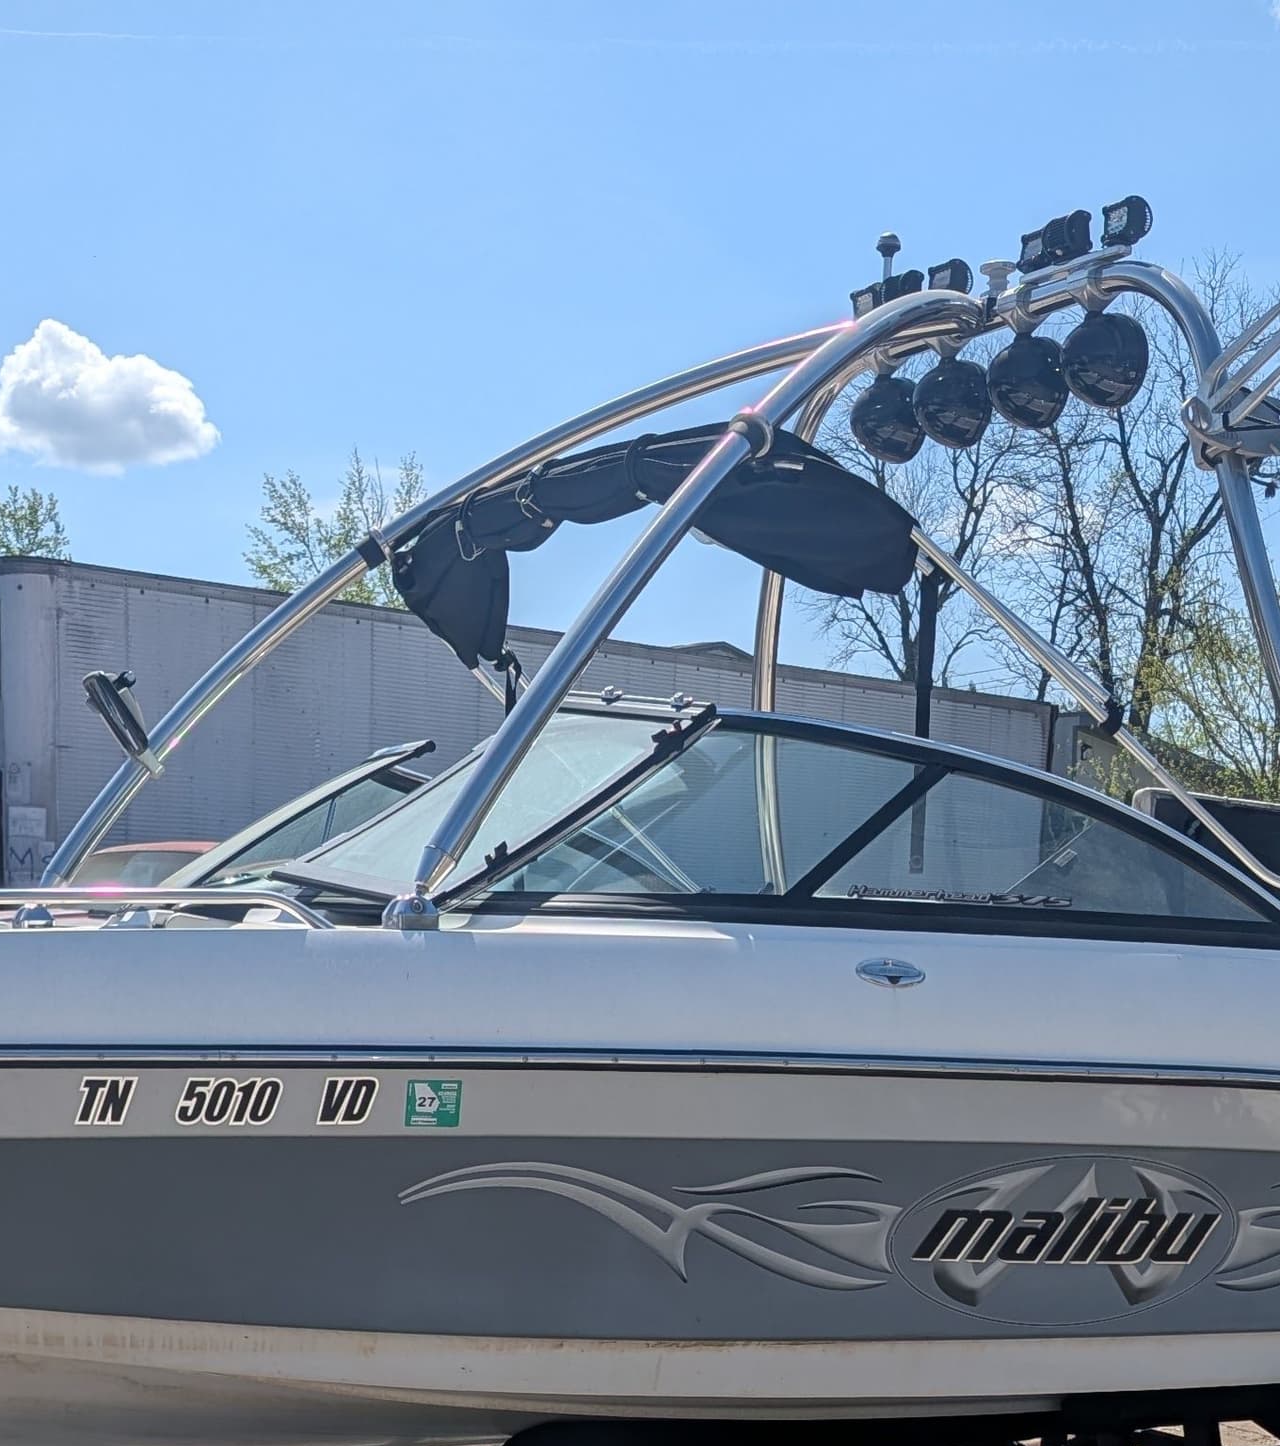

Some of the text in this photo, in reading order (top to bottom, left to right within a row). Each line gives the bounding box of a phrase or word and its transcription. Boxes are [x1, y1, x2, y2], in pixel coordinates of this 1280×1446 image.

[846, 884, 992, 905] Hammerhead
[74, 1076, 380, 1126] TN 5010 VD
[417, 1096, 437, 1108] 27
[911, 1197, 1222, 1265] malibu
